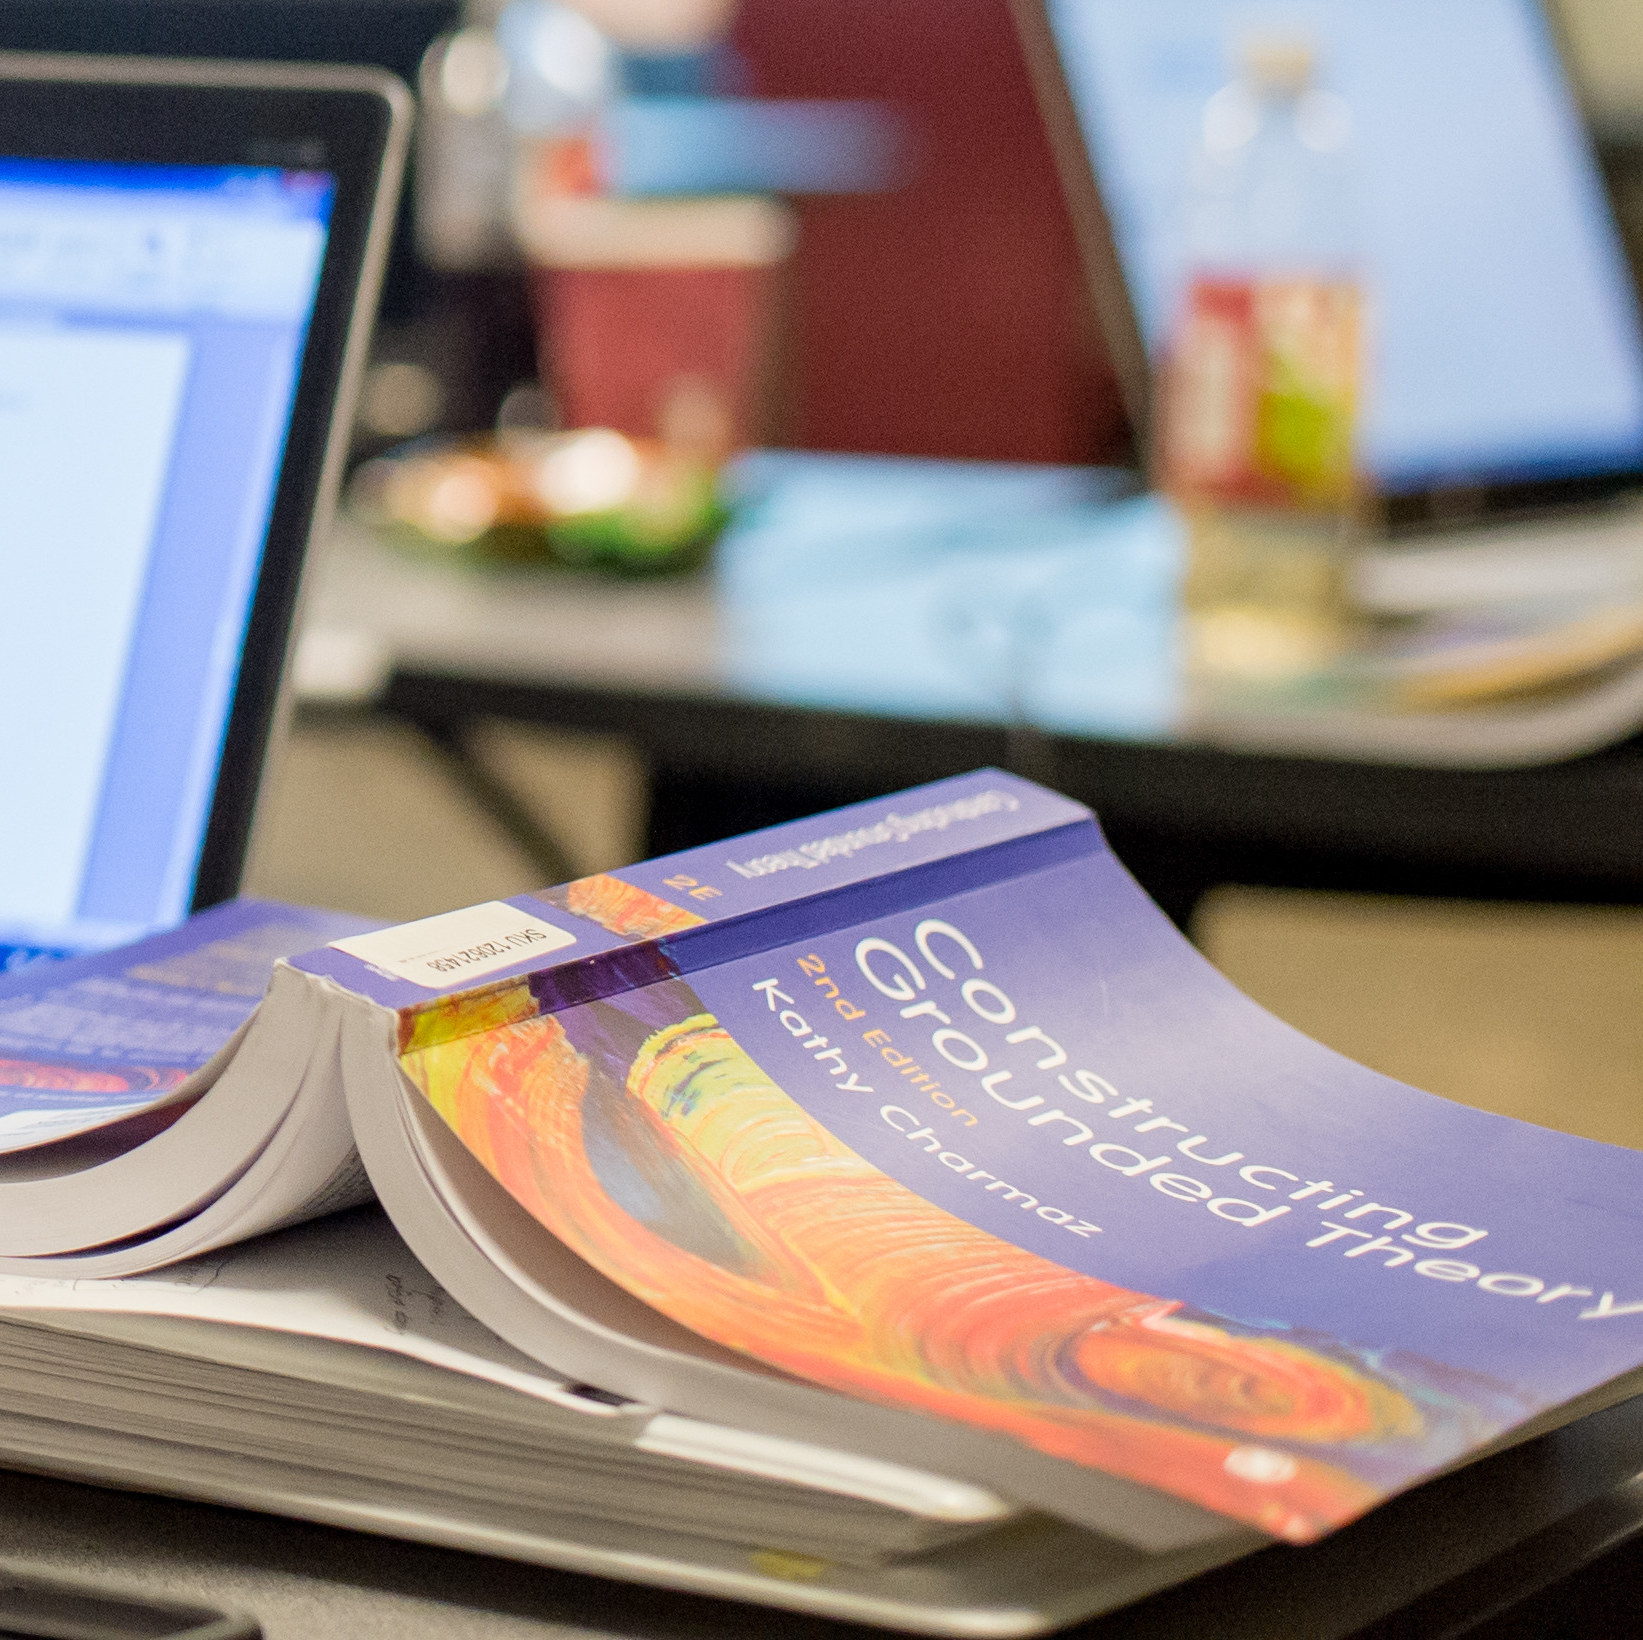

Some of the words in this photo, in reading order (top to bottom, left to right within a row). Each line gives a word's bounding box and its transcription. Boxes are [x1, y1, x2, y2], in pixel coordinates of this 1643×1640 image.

[504, 928, 547, 948] SKU
[662, 874, 722, 901] 2E
[752, 977, 874, 1094] Kathy
[879, 1104, 1104, 1238] Charmaz
[796, 953, 866, 1021] 2nd
[862, 1029, 979, 1127] Edition
[854, 937, 1292, 1227] Grounded
[1305, 1220, 1643, 1320] Theory
[916, 918, 1489, 1249] Constructing
